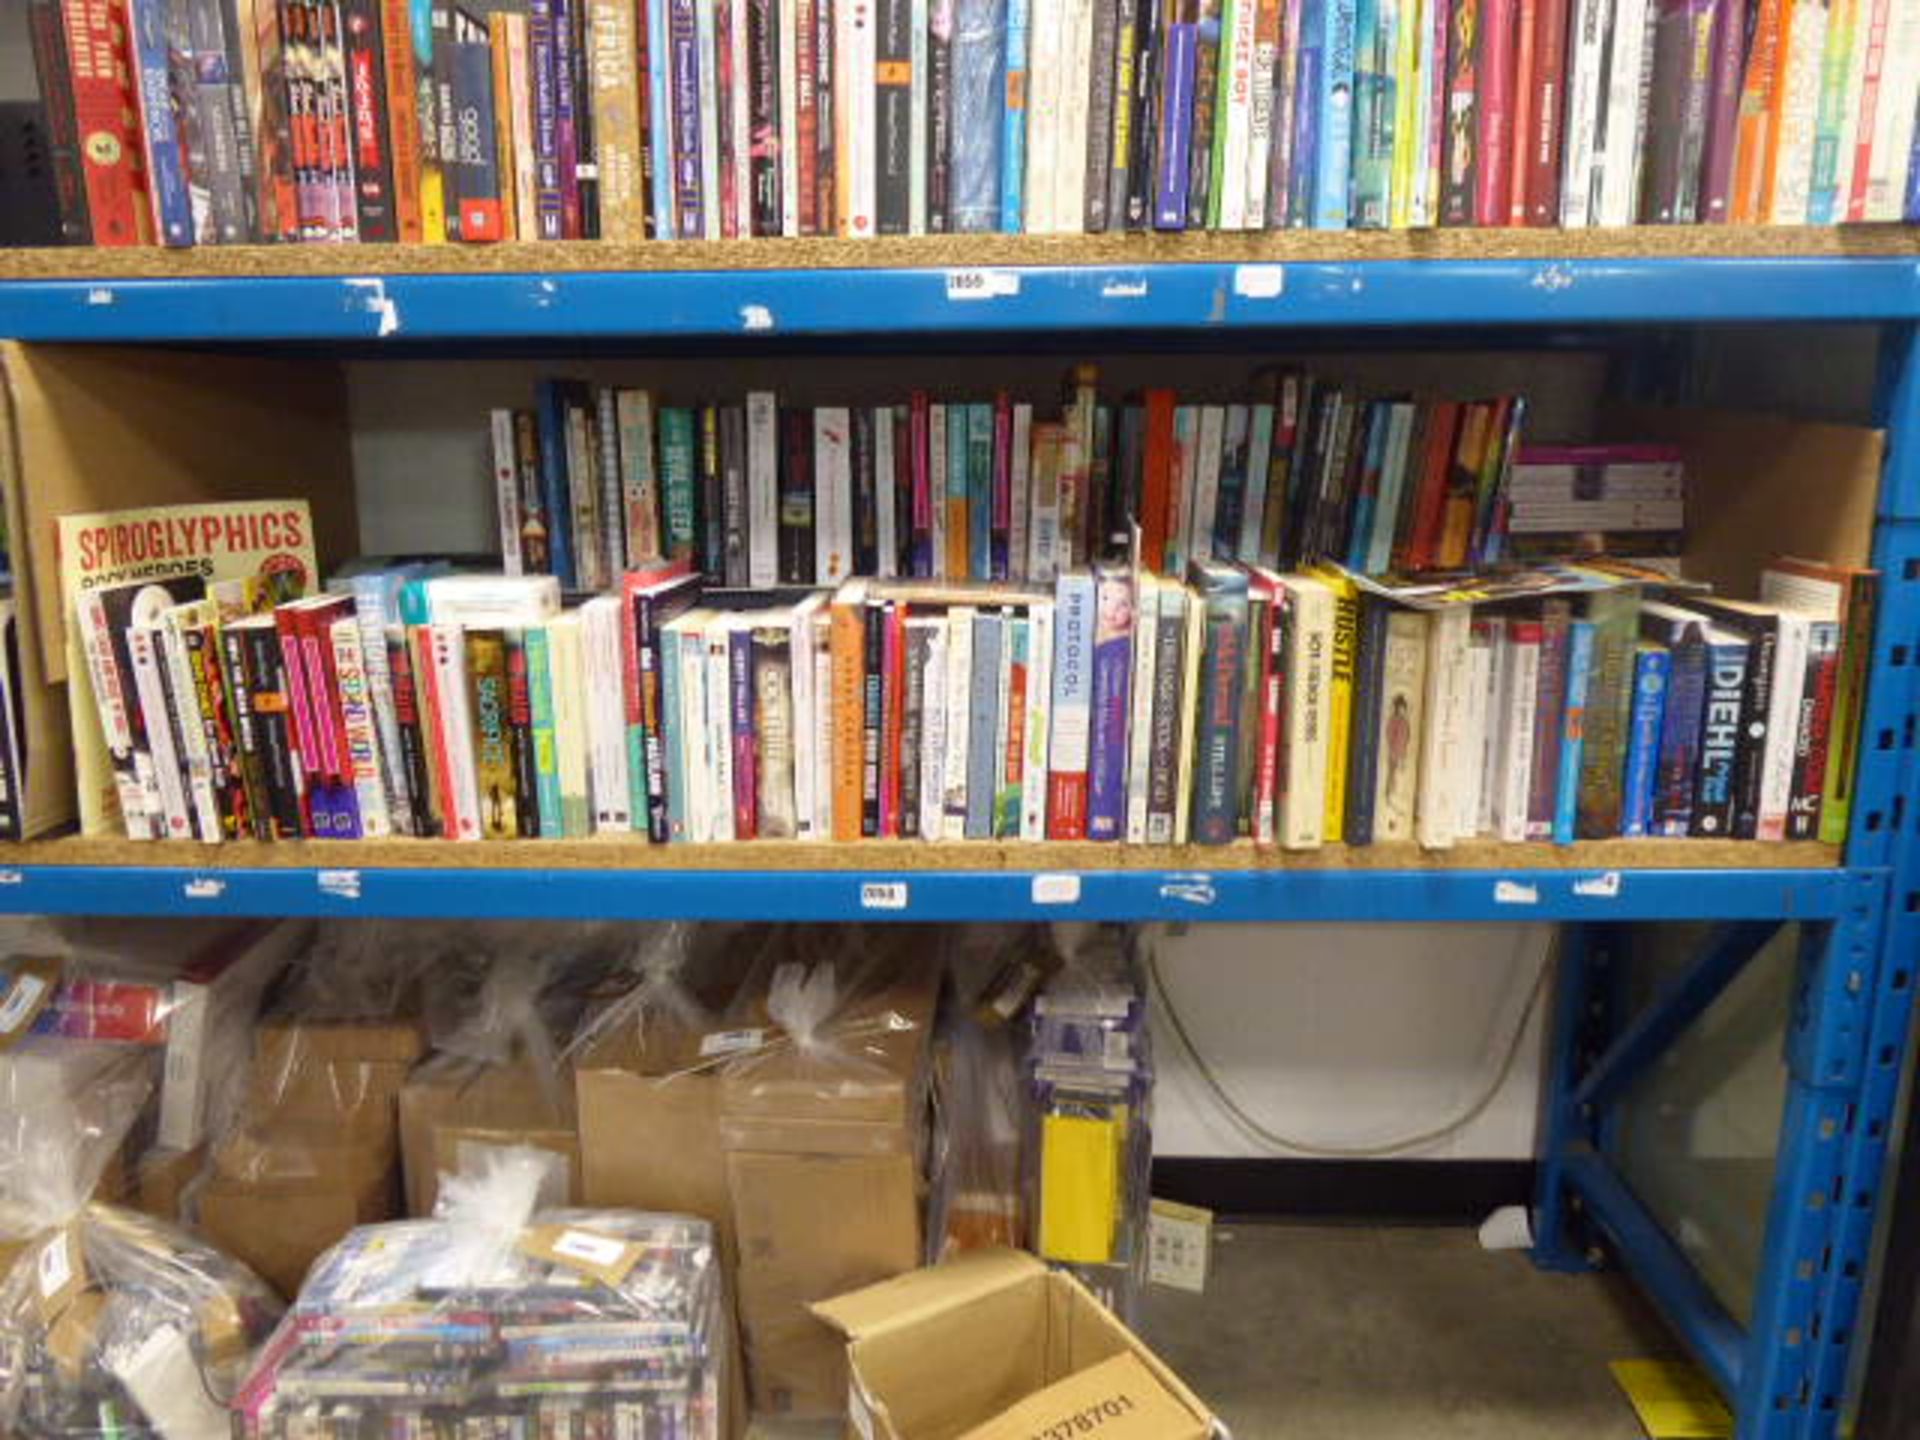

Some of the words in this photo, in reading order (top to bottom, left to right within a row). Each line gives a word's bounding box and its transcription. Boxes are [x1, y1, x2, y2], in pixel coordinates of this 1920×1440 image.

[594, 4, 621, 89] AFRICA
[459, 107, 488, 165] good
[78, 510, 302, 573] SPIROGLYPHICS
[1064, 593, 1083, 699] PROTOCOL
[1331, 597, 1357, 682] HUSTLE
[1703, 664, 1745, 769] DIEHL
[1031, 1395, 1133, 1440] 378701
